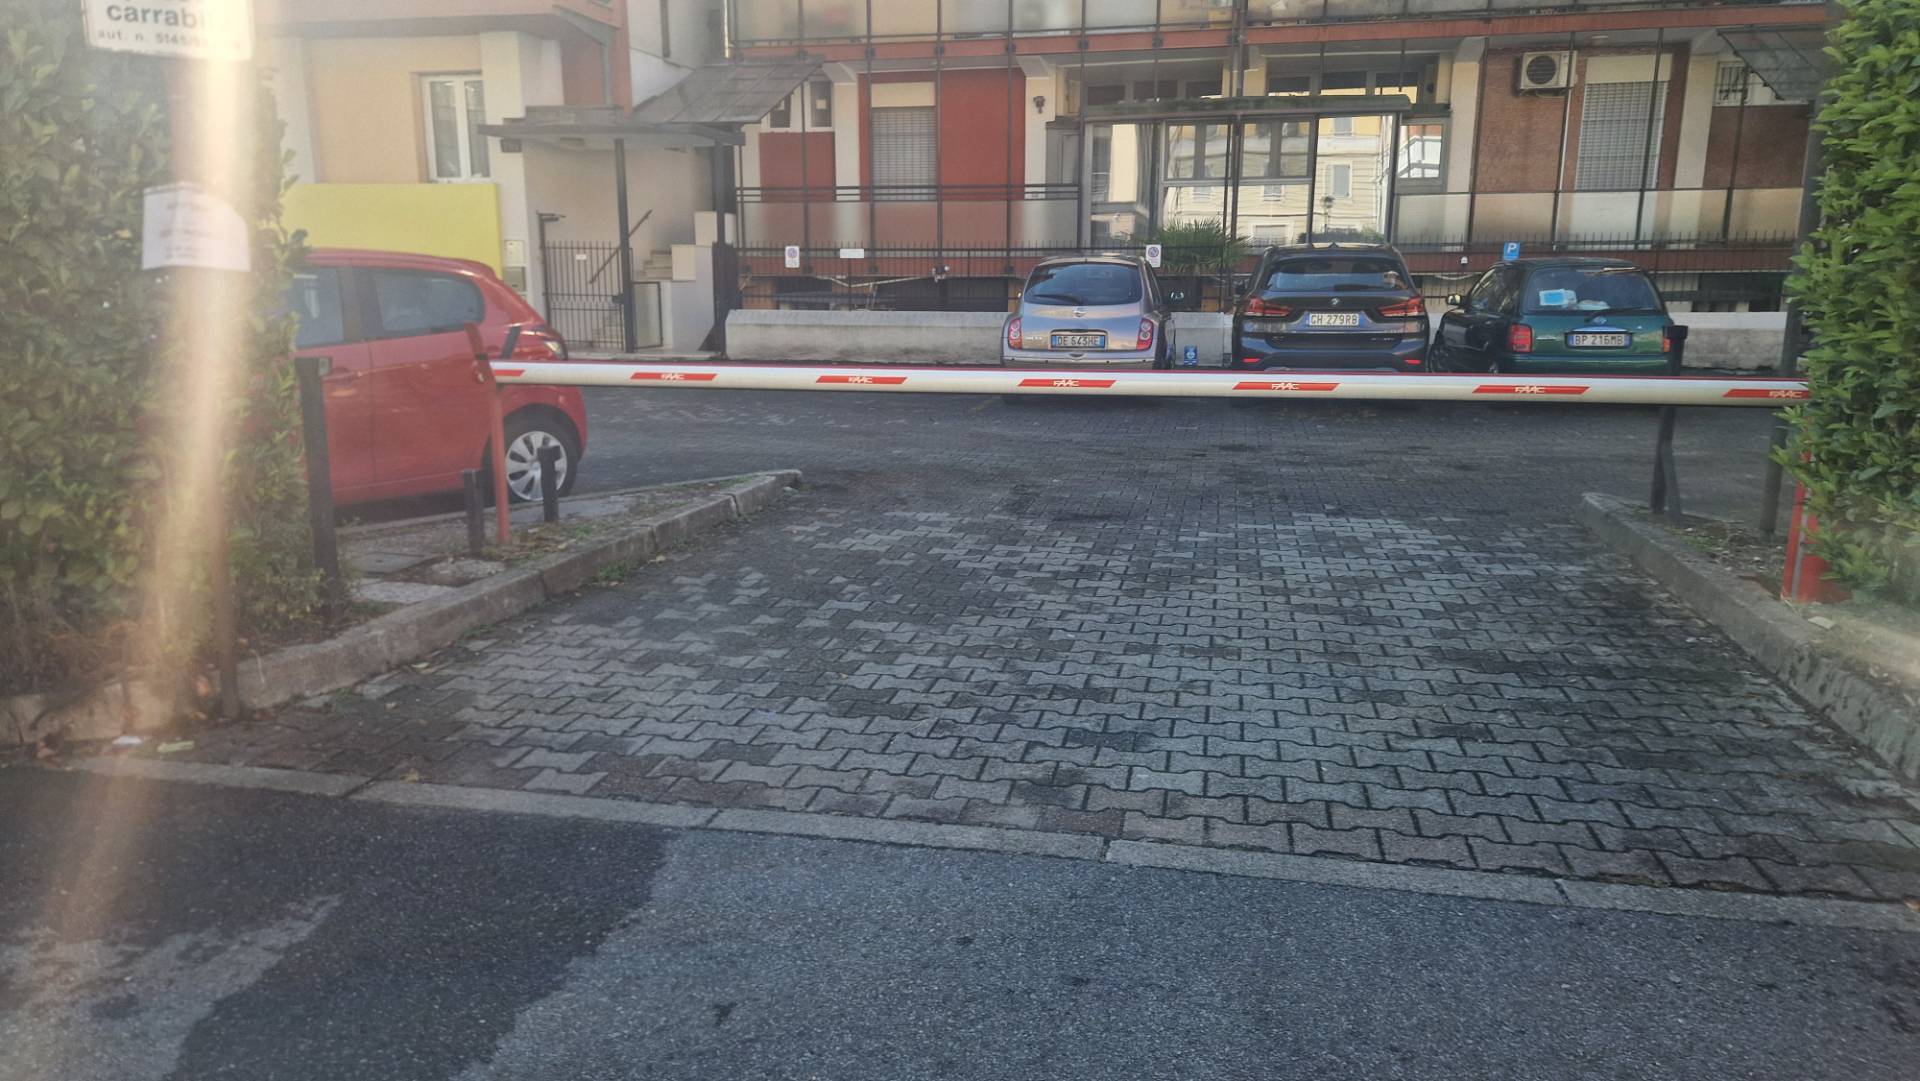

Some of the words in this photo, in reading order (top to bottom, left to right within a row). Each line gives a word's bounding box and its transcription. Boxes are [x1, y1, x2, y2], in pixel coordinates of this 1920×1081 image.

[1507, 243, 1517, 254] P
[1575, 335, 1588, 345] BP
[1053, 380, 1079, 388] FAAC
